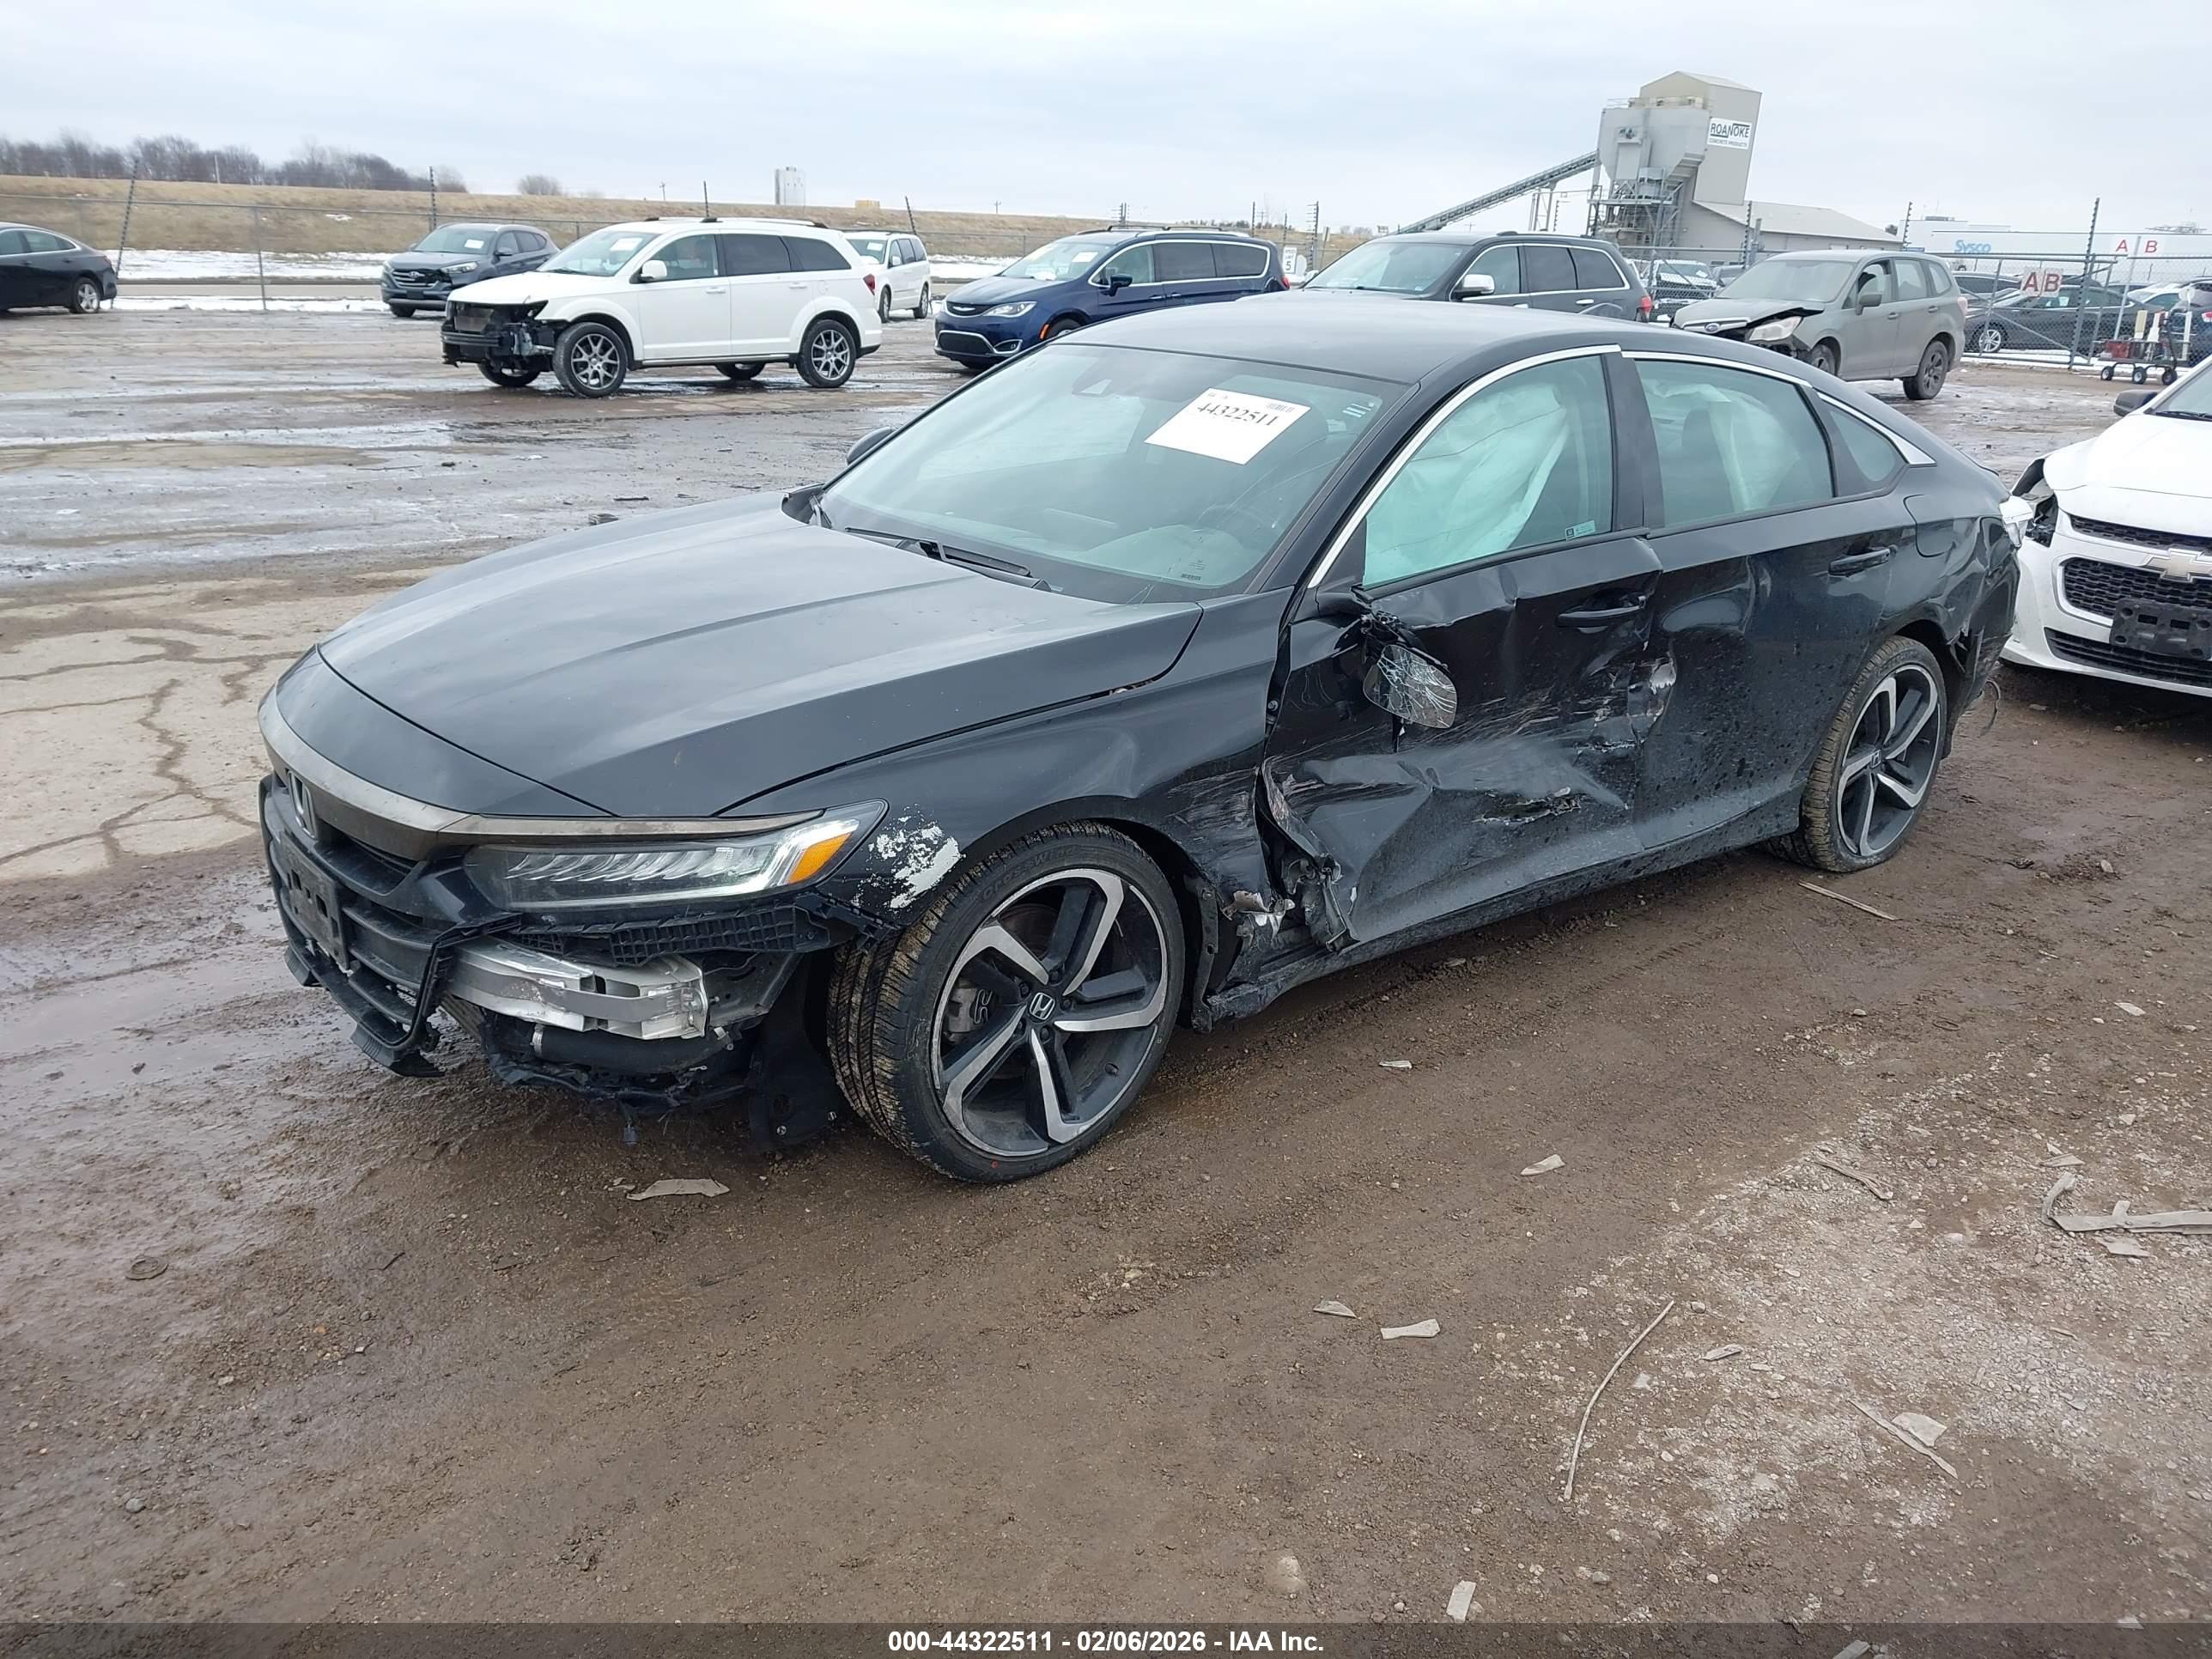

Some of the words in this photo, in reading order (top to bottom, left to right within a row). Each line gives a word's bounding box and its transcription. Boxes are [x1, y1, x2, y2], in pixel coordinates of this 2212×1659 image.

[1711, 123, 1750, 138] ROANOKE
[1954, 240, 1991, 254] Sysco
[2116, 240, 2128, 252] A
[2145, 240, 2158, 253] B
[1285, 260, 1291, 270] 5
[1197, 402, 1279, 426] 44322511
